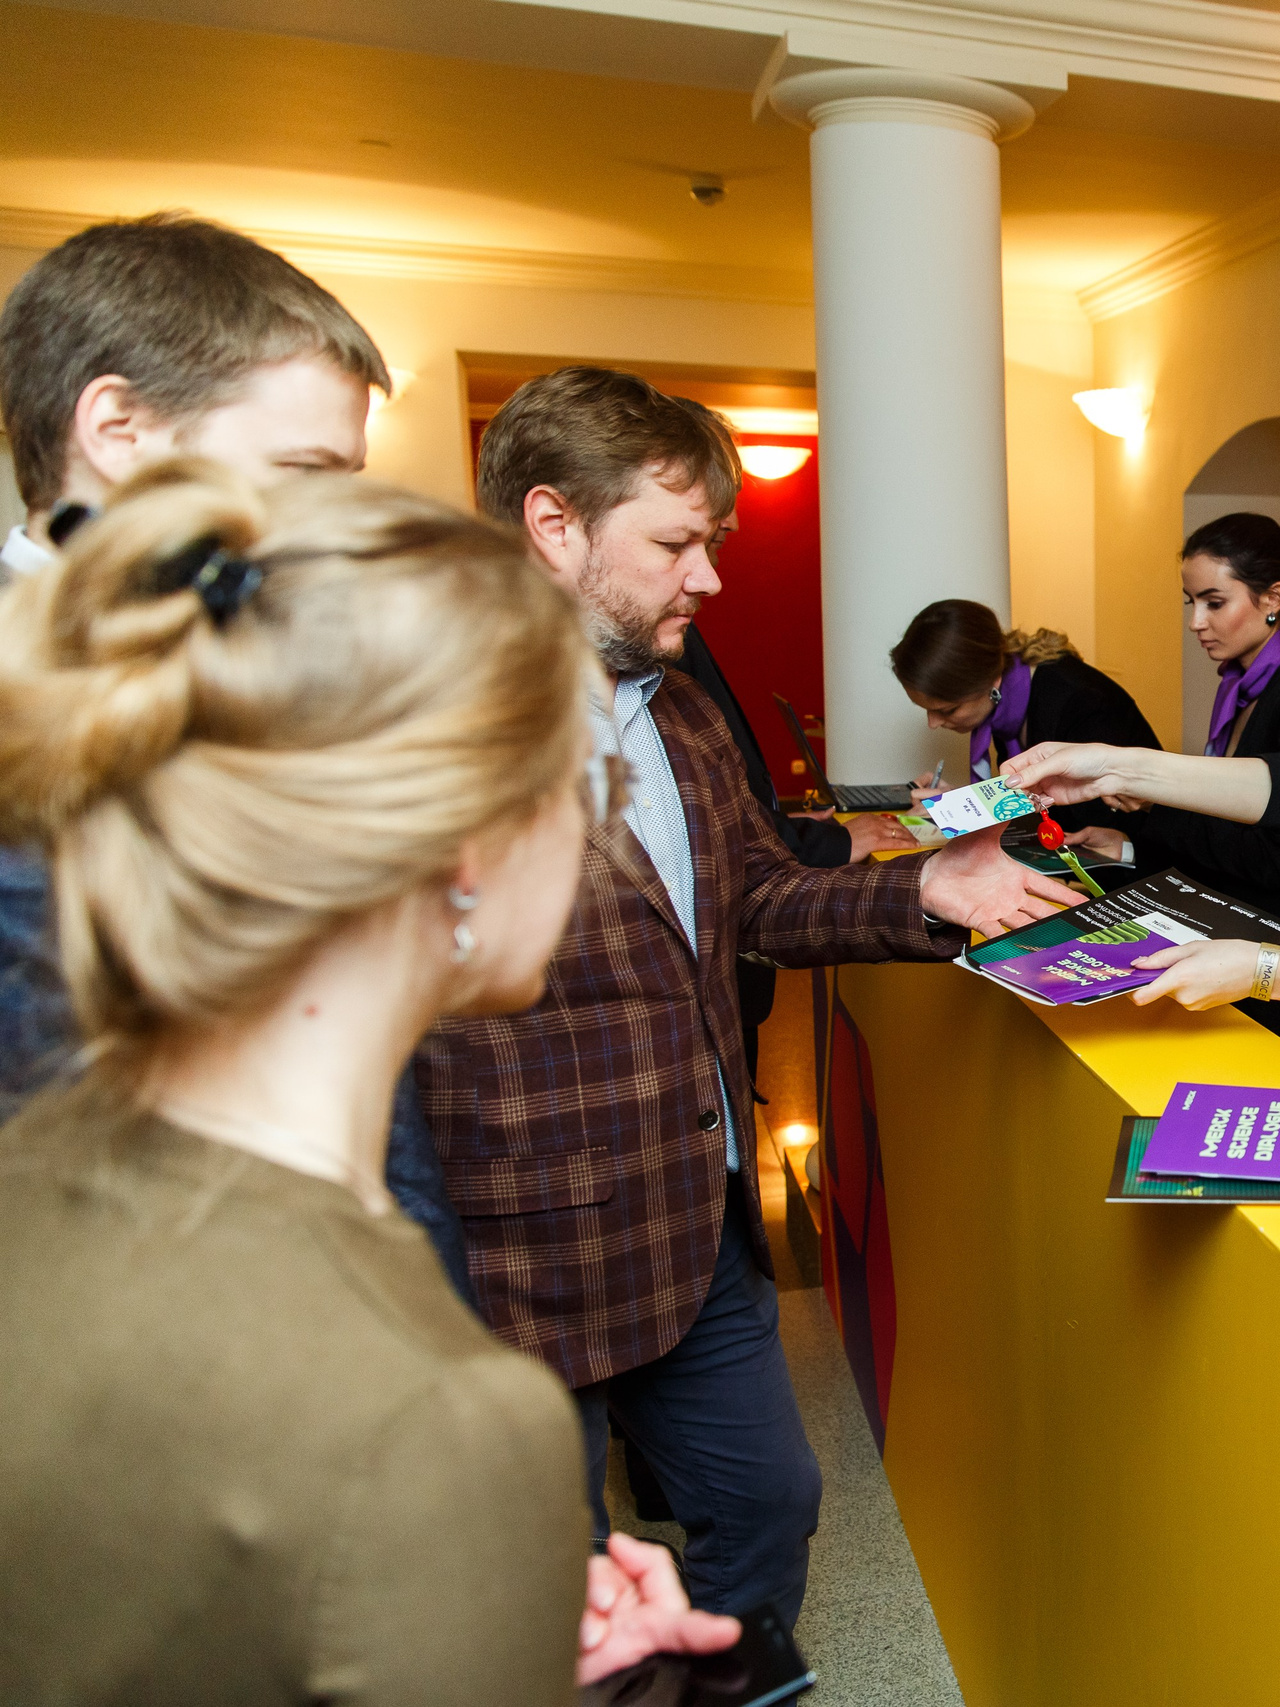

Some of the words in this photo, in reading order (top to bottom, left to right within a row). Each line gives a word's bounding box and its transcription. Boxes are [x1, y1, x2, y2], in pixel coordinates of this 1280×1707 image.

[1041, 965, 1094, 986] MERCK
[1057, 958, 1112, 982] SCIENCE
[1068, 949, 1131, 978] DIALOGUE
[1199, 1108, 1233, 1158] MERCK
[1226, 1106, 1260, 1159] SCIENCE
